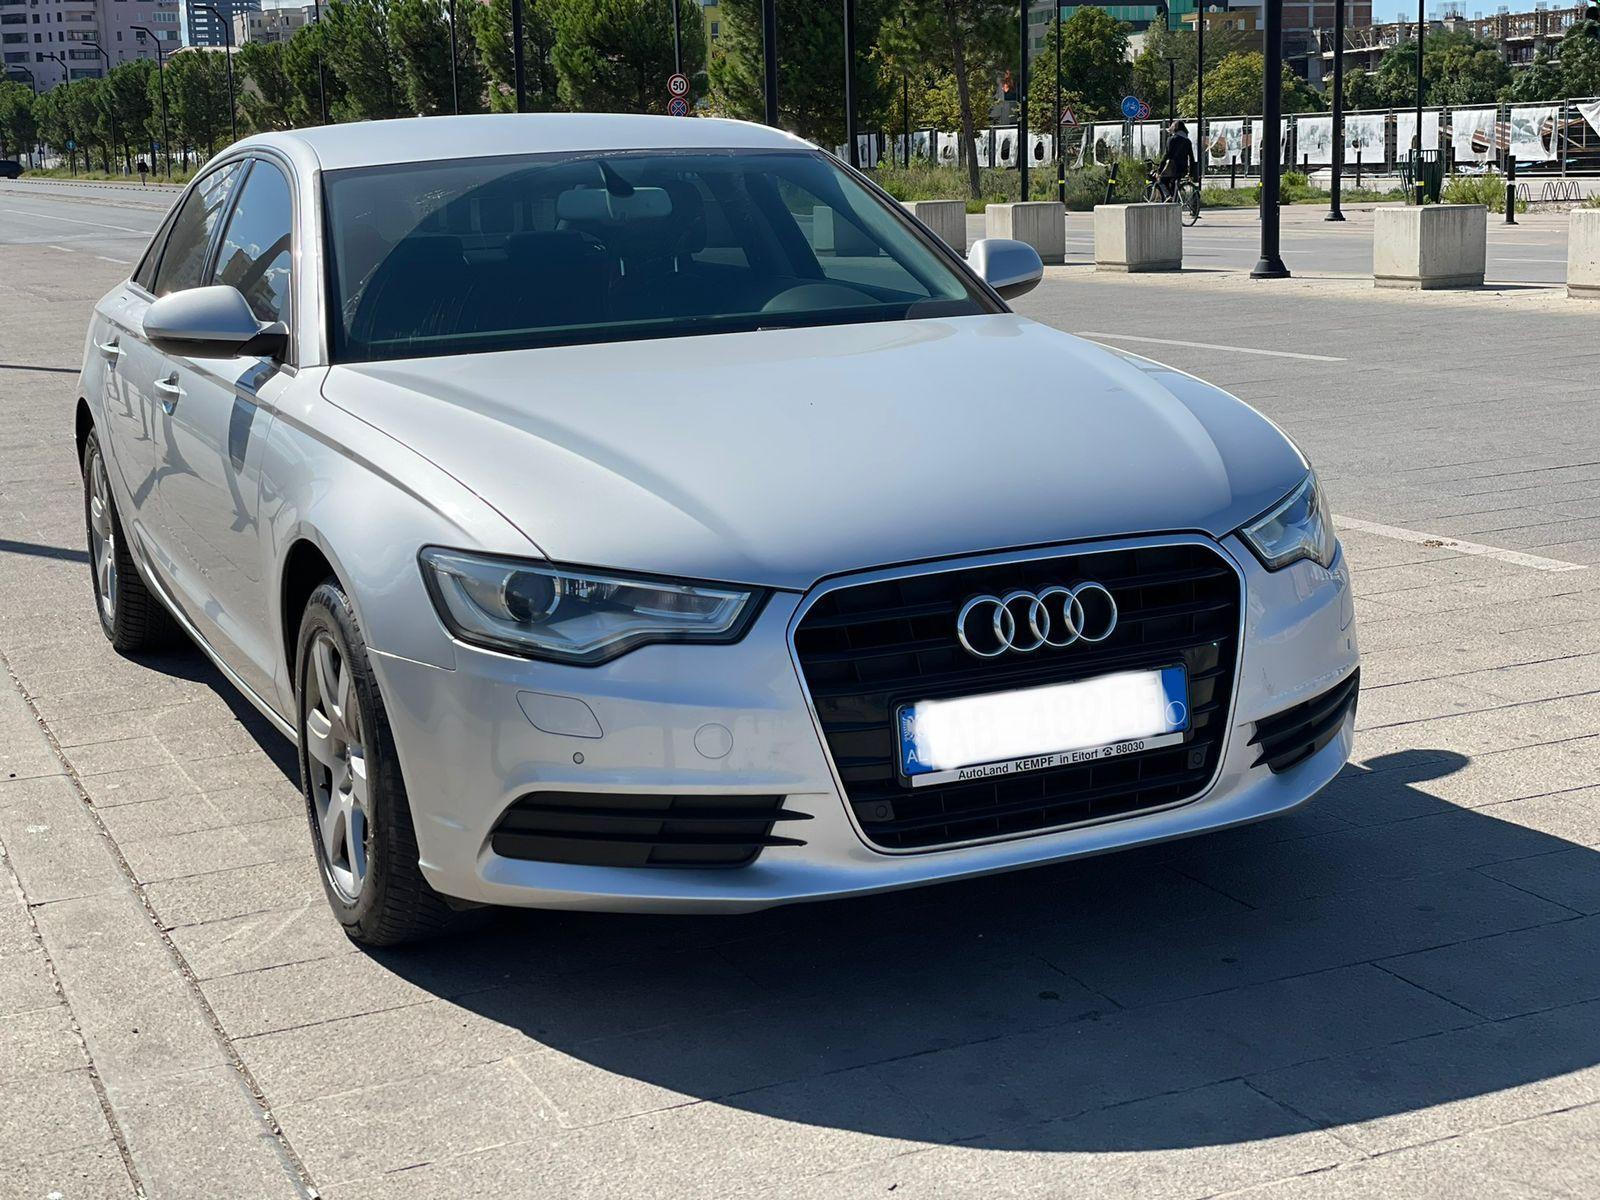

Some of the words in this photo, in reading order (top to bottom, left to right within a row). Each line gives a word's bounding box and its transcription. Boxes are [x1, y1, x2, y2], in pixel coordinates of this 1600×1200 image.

[673, 80, 685, 91] 50
[958, 764, 1009, 780] AutoLand
[1015, 756, 1054, 771] KEMPF
[1059, 754, 1069, 764] in
[1072, 749, 1099, 762] Eitorf
[1116, 741, 1145, 754] 88030
